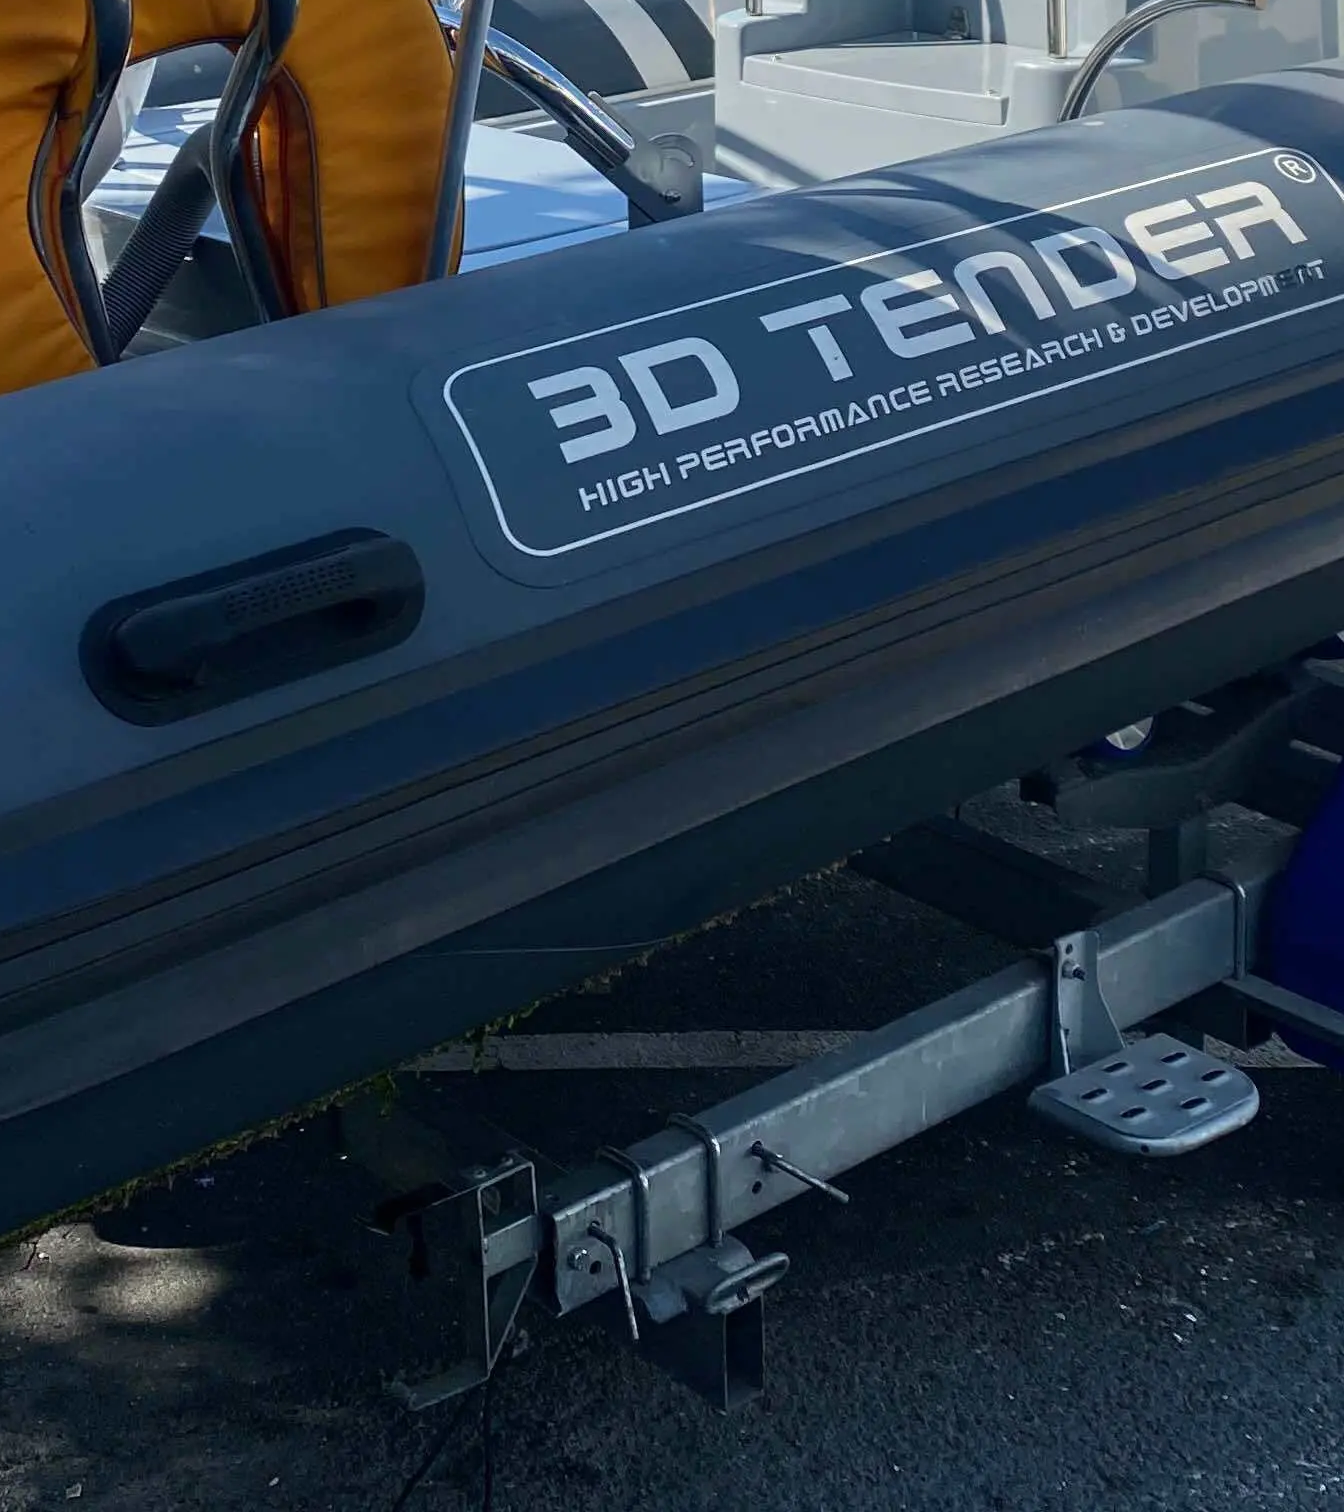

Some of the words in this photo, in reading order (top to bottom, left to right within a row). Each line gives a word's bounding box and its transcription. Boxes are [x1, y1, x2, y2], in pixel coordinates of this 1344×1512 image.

[527, 337, 740, 464] 3D
[759, 181, 1308, 382] TENDER
[578, 462, 672, 512] HIGH
[675, 380, 933, 480] PERFORMANCE
[935, 328, 1104, 398] RESEARCH
[1105, 322, 1127, 345] &
